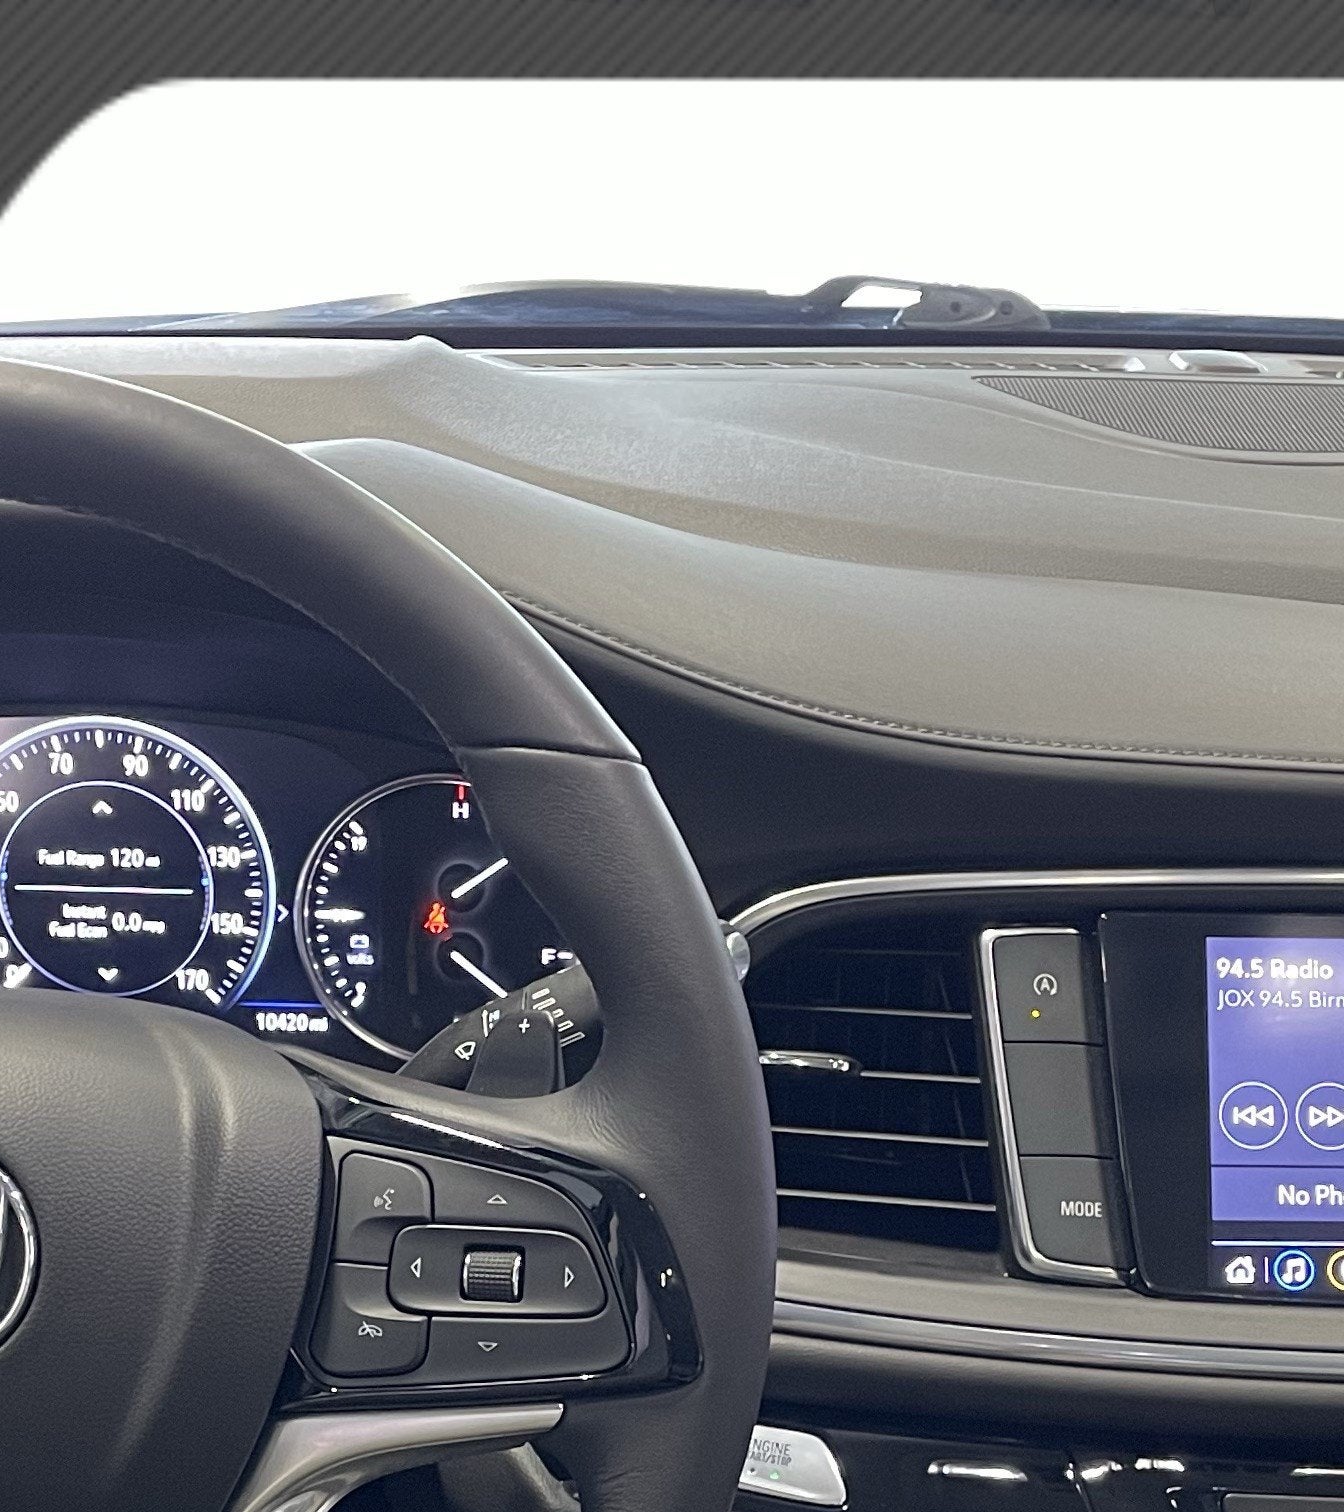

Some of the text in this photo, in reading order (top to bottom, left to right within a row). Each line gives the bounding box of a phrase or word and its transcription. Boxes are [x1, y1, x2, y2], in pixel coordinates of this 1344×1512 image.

[48, 753, 74, 775] 70
[123, 754, 149, 777] 90
[170, 788, 206, 812] 110
[452, 803, 469, 819] H
[110, 848, 145, 868] 120
[207, 847, 241, 868] 130
[111, 912, 142, 932] 0.0
[211, 913, 244, 934] 150
[542, 949, 556, 965] F
[1216, 957, 1334, 980] 94.5 Radio
[177, 970, 209, 990] 170
[1216, 989, 1255, 1011] JOX
[1259, 990, 1303, 1008] 94.5
[256, 1012, 308, 1032] 10420
[1278, 1184, 1311, 1206] No
[1061, 1201, 1103, 1218] MODE
[751, 1439, 792, 1456] NGINE
[750, 1451, 792, 1467] ART/STOP
